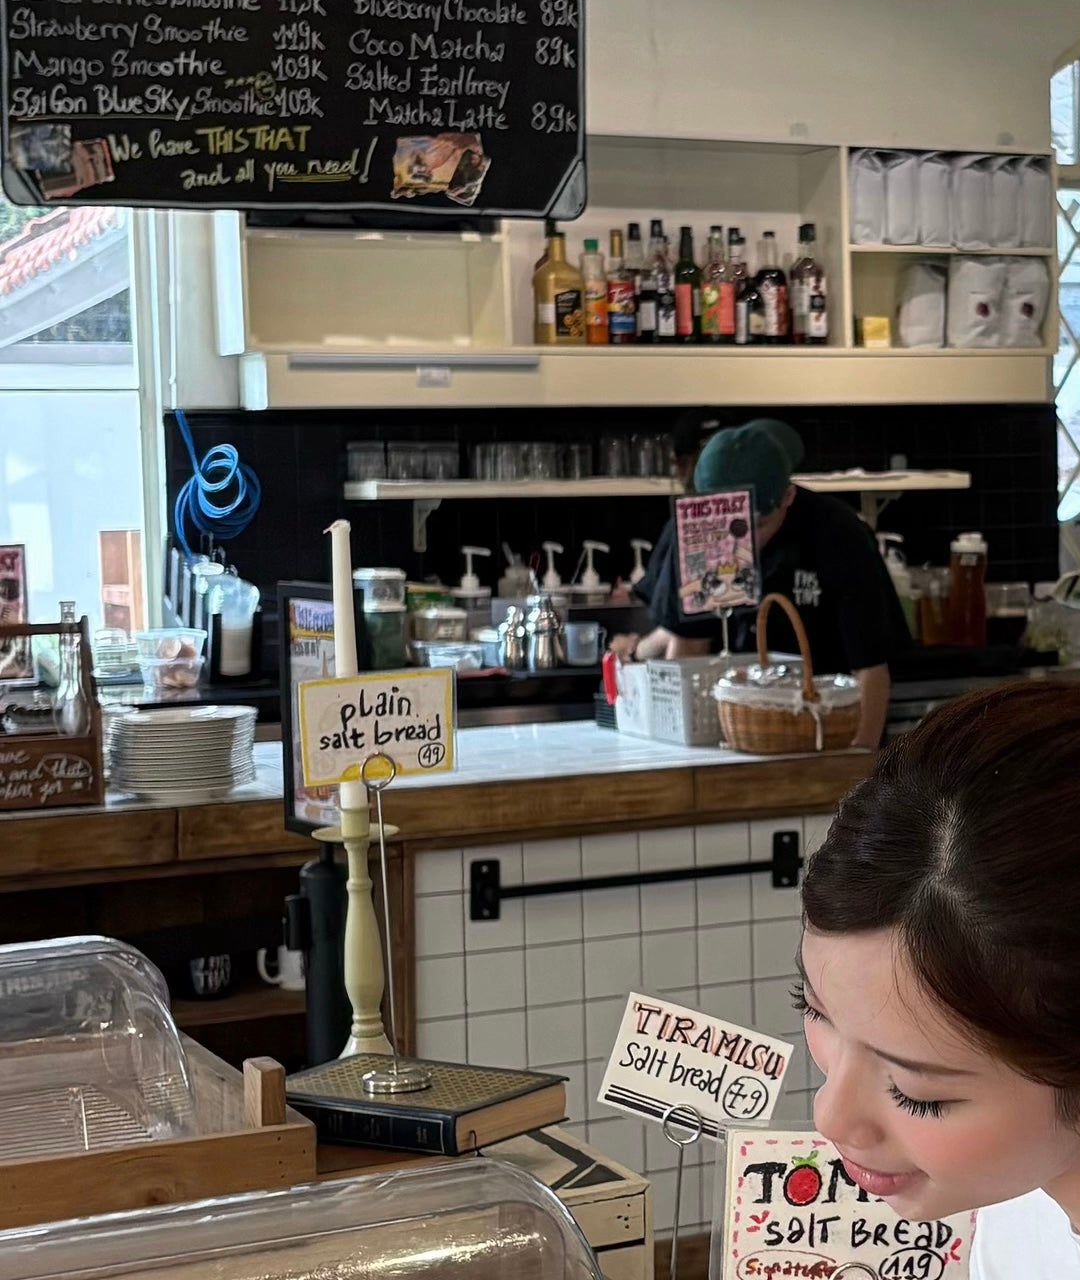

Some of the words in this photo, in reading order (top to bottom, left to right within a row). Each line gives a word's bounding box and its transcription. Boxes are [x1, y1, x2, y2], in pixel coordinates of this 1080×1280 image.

[9, 7, 138, 48] Strawberry
[143, 13, 249, 44] Smoothie
[349, 29, 404, 57] Coco
[408, 30, 505, 62] Matcha
[13, 50, 104, 85] Mango
[111, 49, 226, 78] Smoothie
[345, 59, 411, 93] Salted
[191, 86, 276, 117] Smoothie
[363, 97, 444, 127] Matcha
[444, 99, 509, 132] Latte
[108, 133, 142, 163] We
[149, 128, 200, 160] have
[179, 163, 232, 191] and
[235, 158, 255, 184] all
[264, 160, 299, 192] you
[319, 726, 364, 751] salt
[374, 714, 442, 746] bread
[634, 1001, 785, 1081] TIRAMISU
[669, 1054, 728, 1103] bread
[726, 1081, 765, 1116] 79
[884, 1253, 932, 1280] 119
